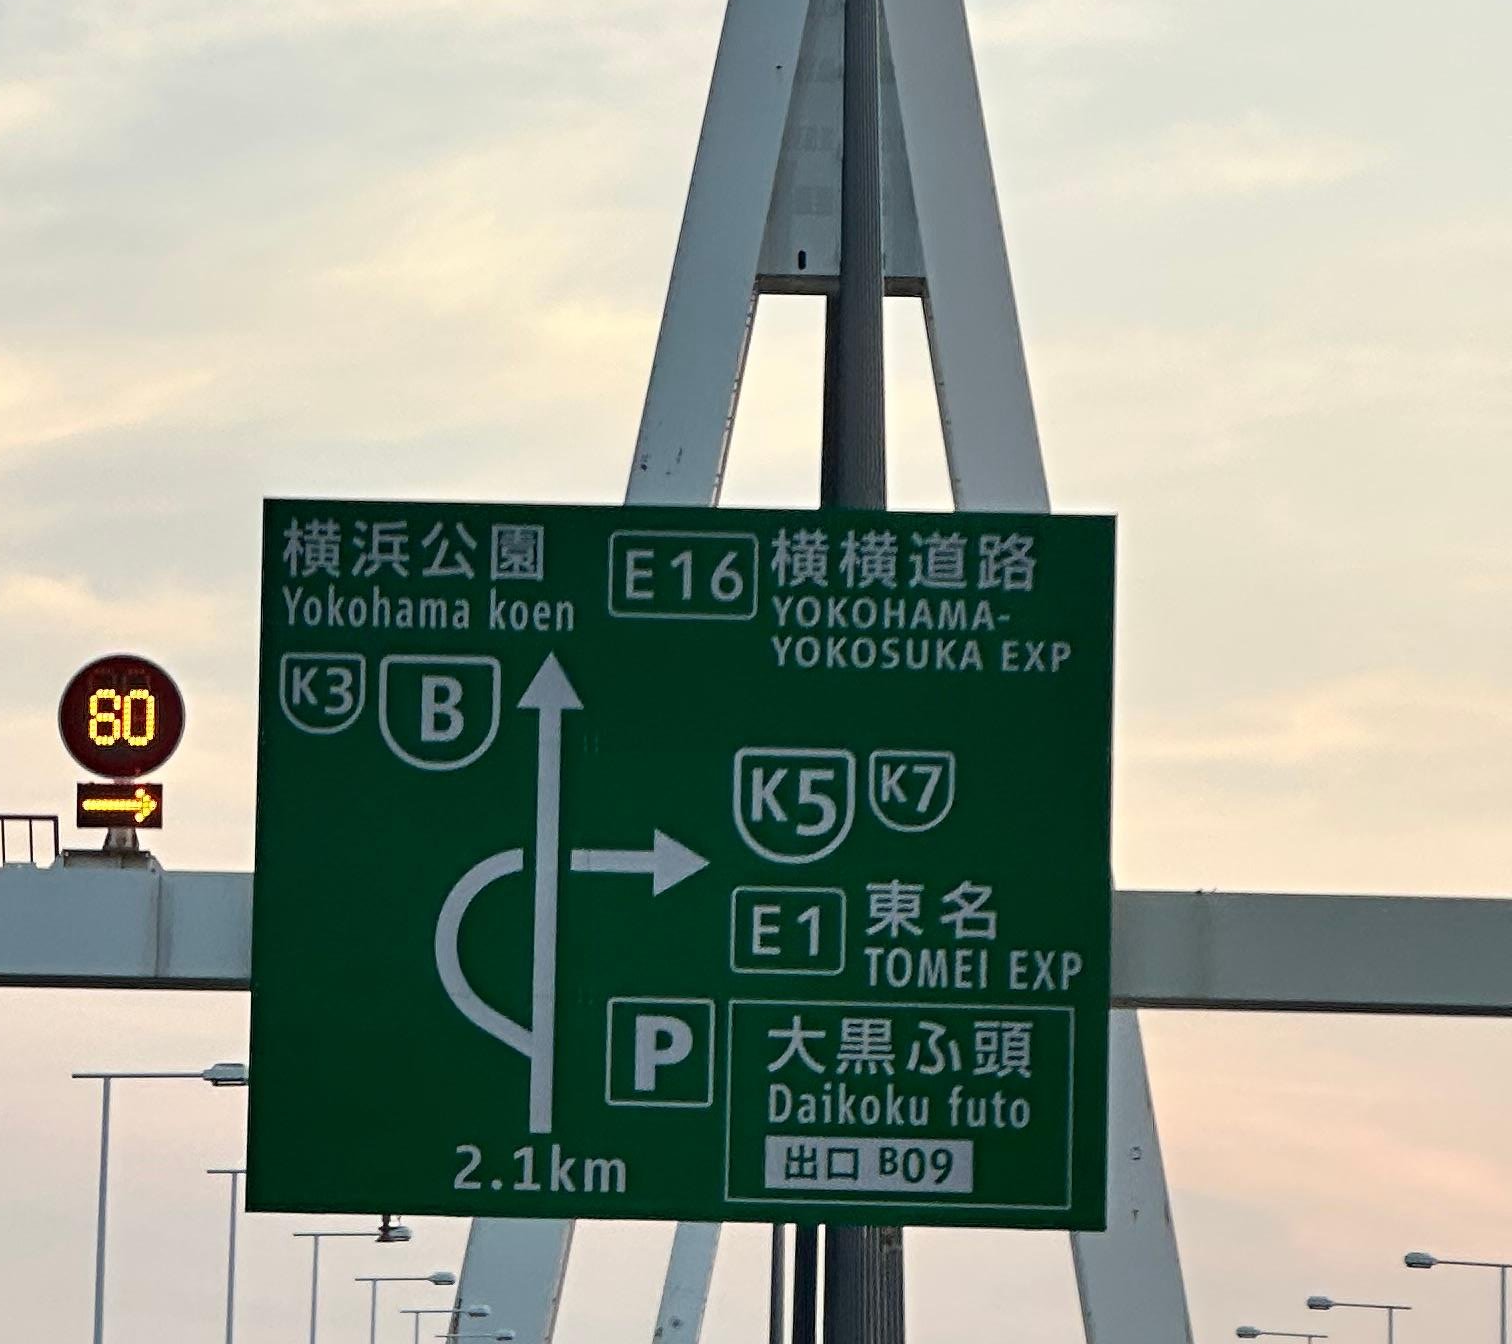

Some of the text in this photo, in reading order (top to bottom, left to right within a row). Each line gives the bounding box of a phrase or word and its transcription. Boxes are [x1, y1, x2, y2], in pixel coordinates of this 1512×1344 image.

[283, 518, 545, 583] 横浜公園
[626, 550, 744, 602] E16
[770, 529, 1037, 592] 横横道路
[283, 588, 575, 632] Yokohama koen
[771, 595, 1011, 631] YOKOHAMA-
[772, 636, 1072, 673] YOKOSUKA EXP
[291, 667, 356, 716] K3
[420, 676, 465, 743] B
[89, 689, 155, 746] 60
[750, 769, 838, 838] K5
[880, 764, 943, 814] K7
[752, 905, 822, 956] E1
[865, 879, 998, 940] 東名
[864, 947, 1082, 991] TOMEI EXP
[634, 1016, 694, 1091] P
[766, 1015, 1034, 1079] 大黒ふ頭
[768, 1083, 1031, 1129] Daikoku futo
[453, 1144, 626, 1193] 2.1km
[784, 1145, 954, 1185] 出口 B09
